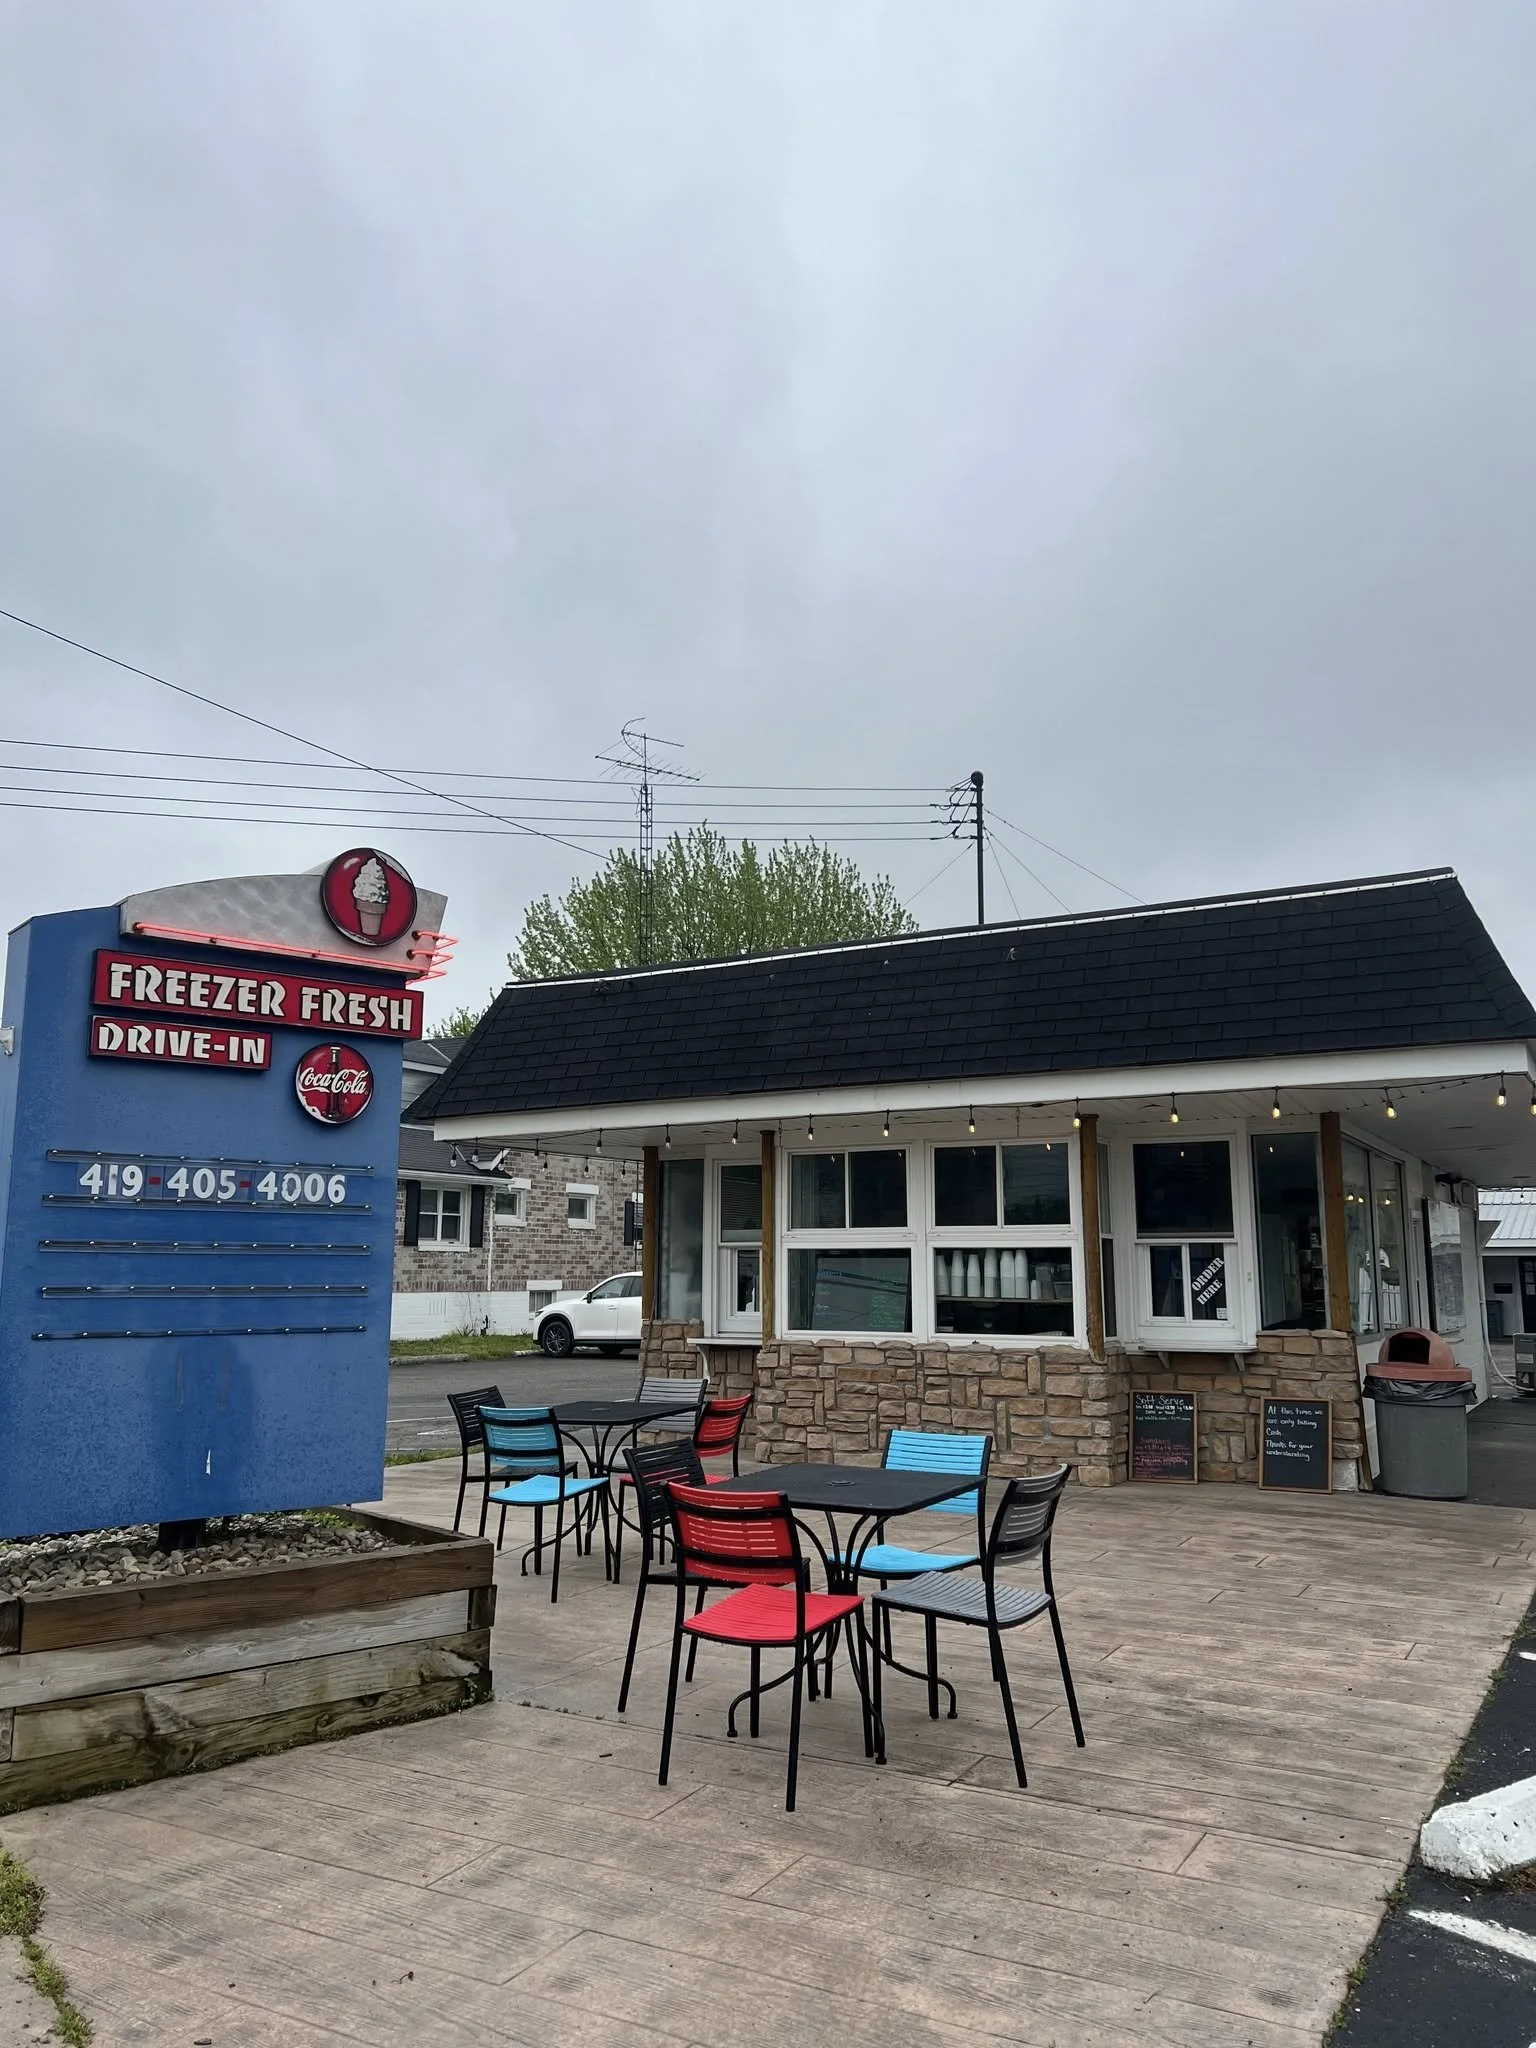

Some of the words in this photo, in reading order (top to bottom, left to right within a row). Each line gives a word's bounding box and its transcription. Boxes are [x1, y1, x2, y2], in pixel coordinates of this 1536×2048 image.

[110, 962, 286, 1016] FREEZER
[301, 986, 413, 1031] FRESH
[98, 1022, 265, 1064] DRIVE-IN
[299, 1067, 369, 1095] Coca-Cola
[79, 1163, 346, 1204] 419-405-4006
[1192, 1257, 1224, 1291] ORDER
[1197, 1279, 1223, 1305] HERE
[1136, 1395, 1155, 1405] Soft
[1159, 1395, 1184, 1406] Serve
[1268, 1405, 1276, 1415] At
[1281, 1407, 1294, 1415] this
[1266, 1427, 1282, 1436] Cash
[1280, 1419, 1295, 1427] only
[1297, 1419, 1317, 1429] taking
[1265, 1440, 1286, 1448] Thanks
[1288, 1441, 1297, 1449] for
[1266, 1450, 1310, 1461] understanding
